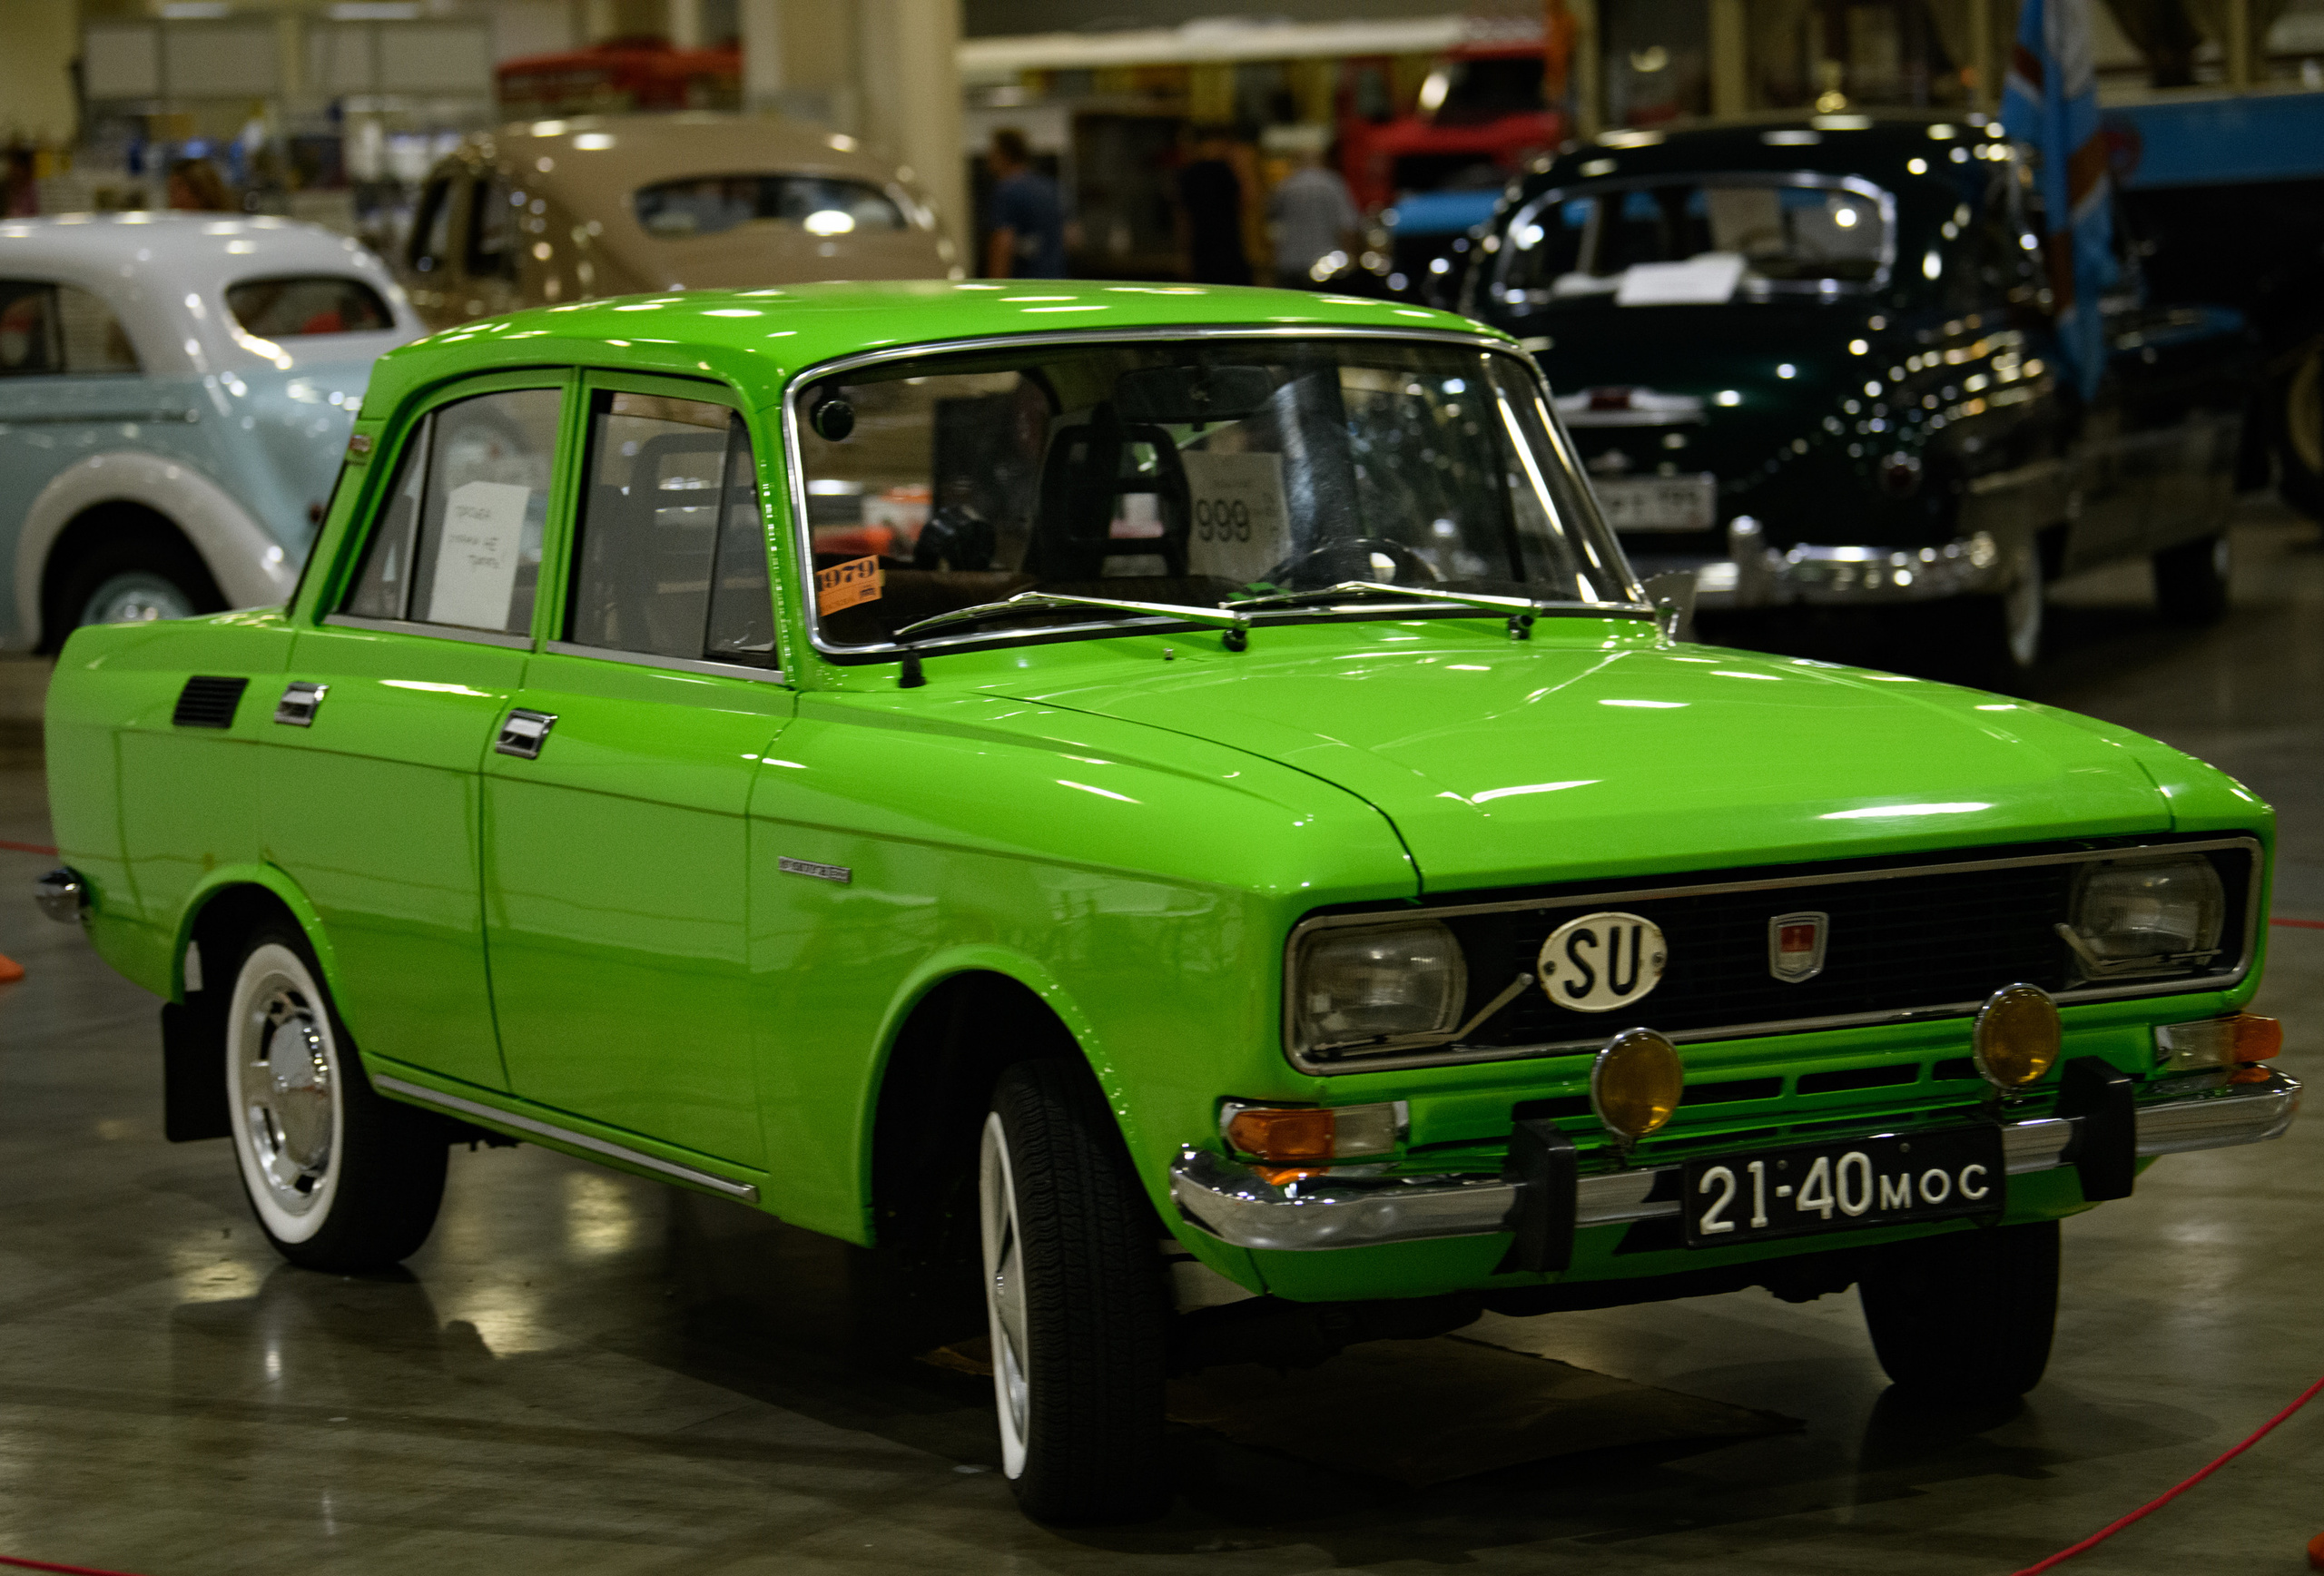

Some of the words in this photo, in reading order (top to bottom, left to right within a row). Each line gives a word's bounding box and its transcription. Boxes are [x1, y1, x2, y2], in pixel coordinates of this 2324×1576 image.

[1196, 498, 1251, 542] 999
[816, 560, 875, 592] 1979
[1563, 925, 1641, 999] SU
